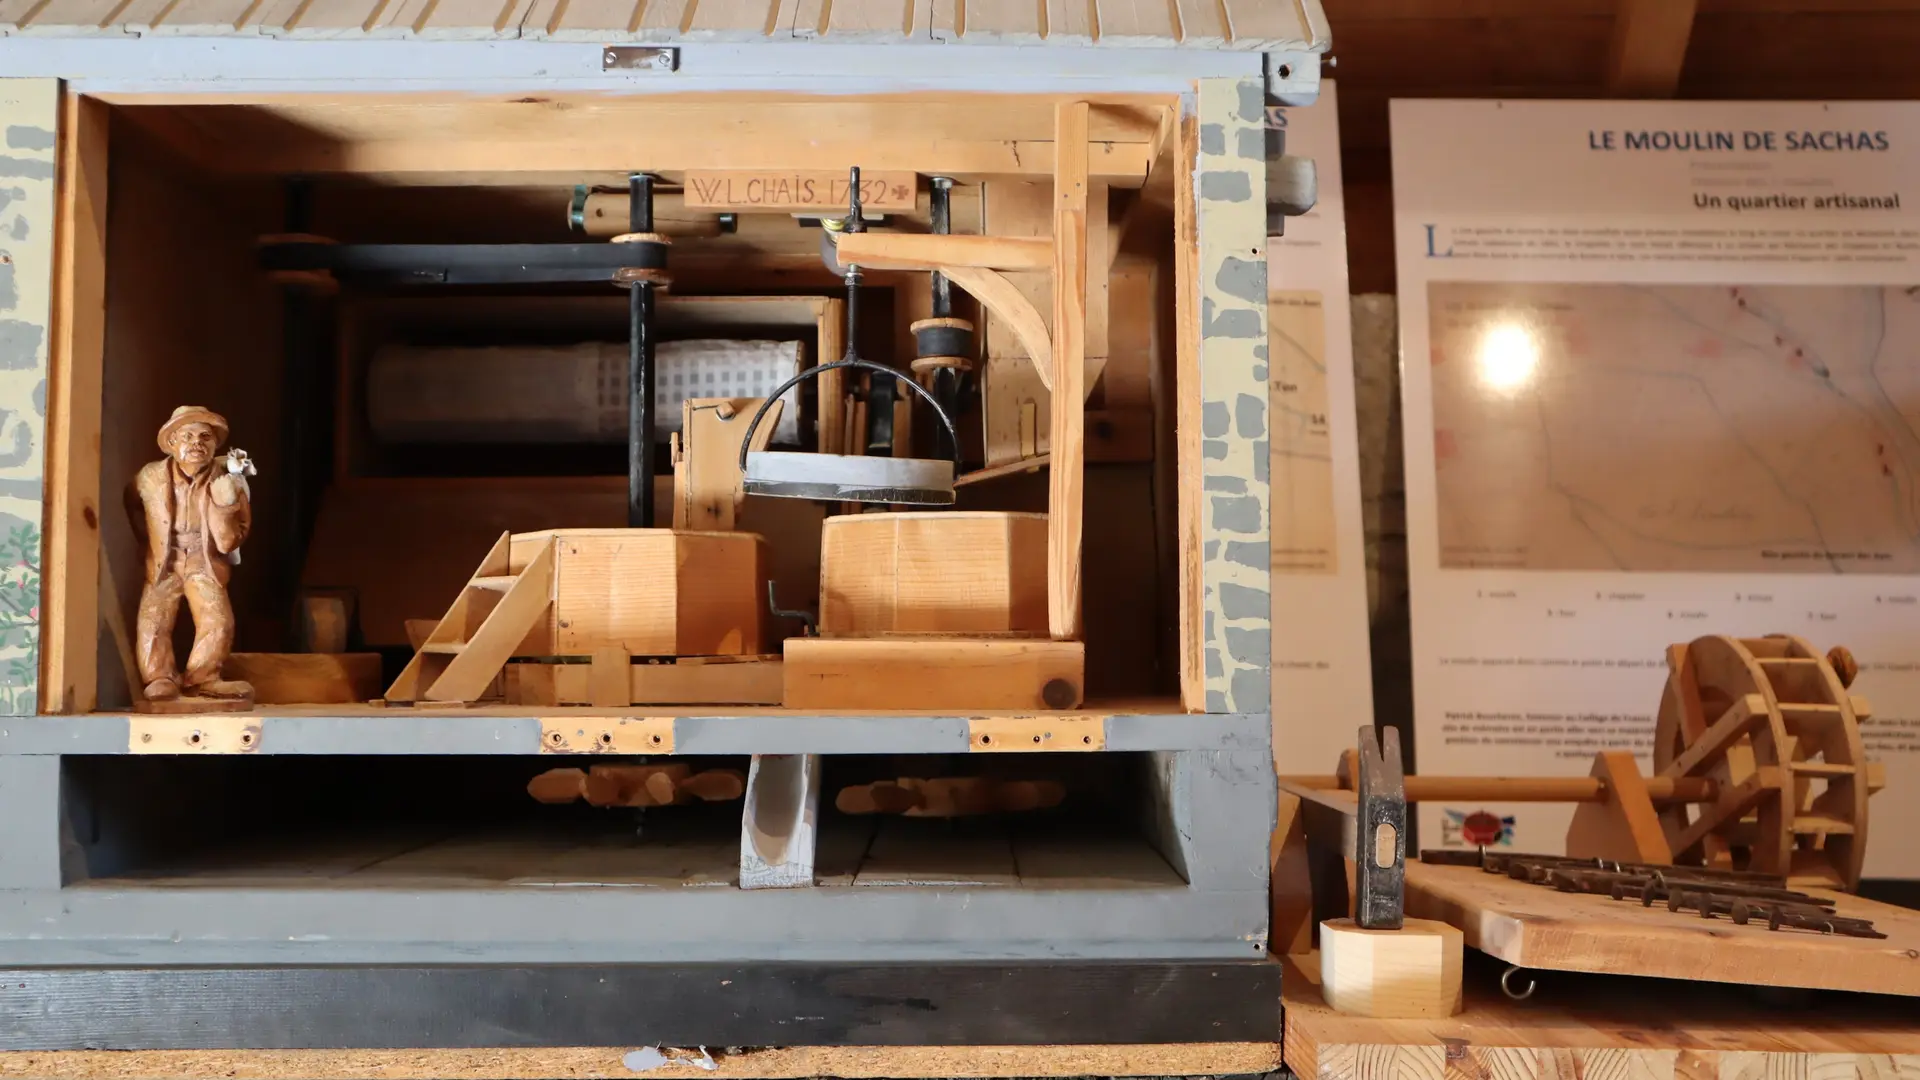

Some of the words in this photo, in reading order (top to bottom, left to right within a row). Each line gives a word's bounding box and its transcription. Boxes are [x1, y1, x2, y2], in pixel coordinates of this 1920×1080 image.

[1588, 130, 1616, 150] LE
[1624, 130, 1735, 151] MOULIN
[1743, 131, 1777, 151] DE
[1785, 131, 1890, 152] SACHAS
[1693, 193, 1722, 209] Un
[1727, 193, 1807, 212] quartier
[1813, 193, 1901, 210] artisanal
